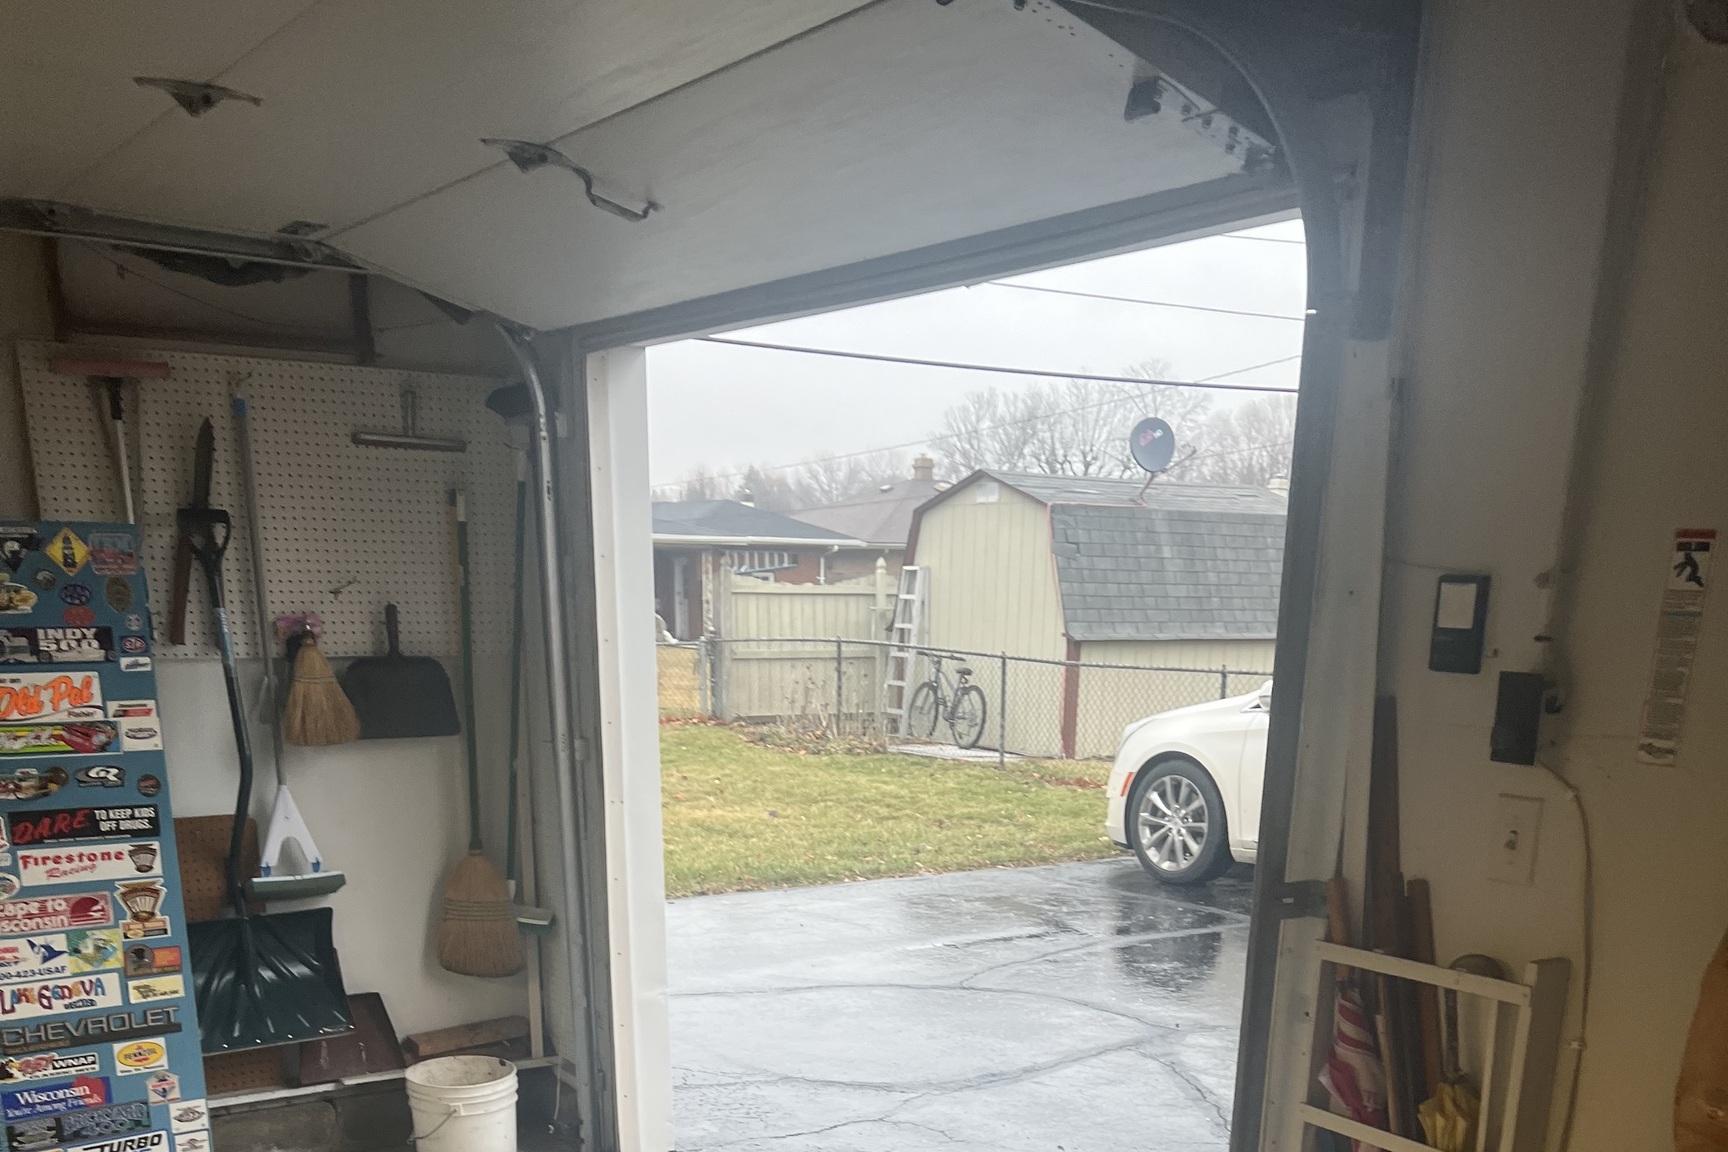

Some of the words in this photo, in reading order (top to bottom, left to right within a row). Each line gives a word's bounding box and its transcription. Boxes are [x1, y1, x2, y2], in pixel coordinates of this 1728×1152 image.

[36, 628, 97, 639] INDY
[38, 639, 100, 651] 500
[42, 675, 94, 711] Pal
[94, 809, 107, 820] TO
[108, 808, 132, 819] KEEP
[133, 807, 156, 818] KIDS
[99, 821, 118, 831] OFF
[20, 851, 125, 870] Firestone
[2, 1007, 178, 1046] CHEVROLET
[53, 1056, 95, 1068] WNAP
[15, 1085, 91, 1105] Wisconsin
